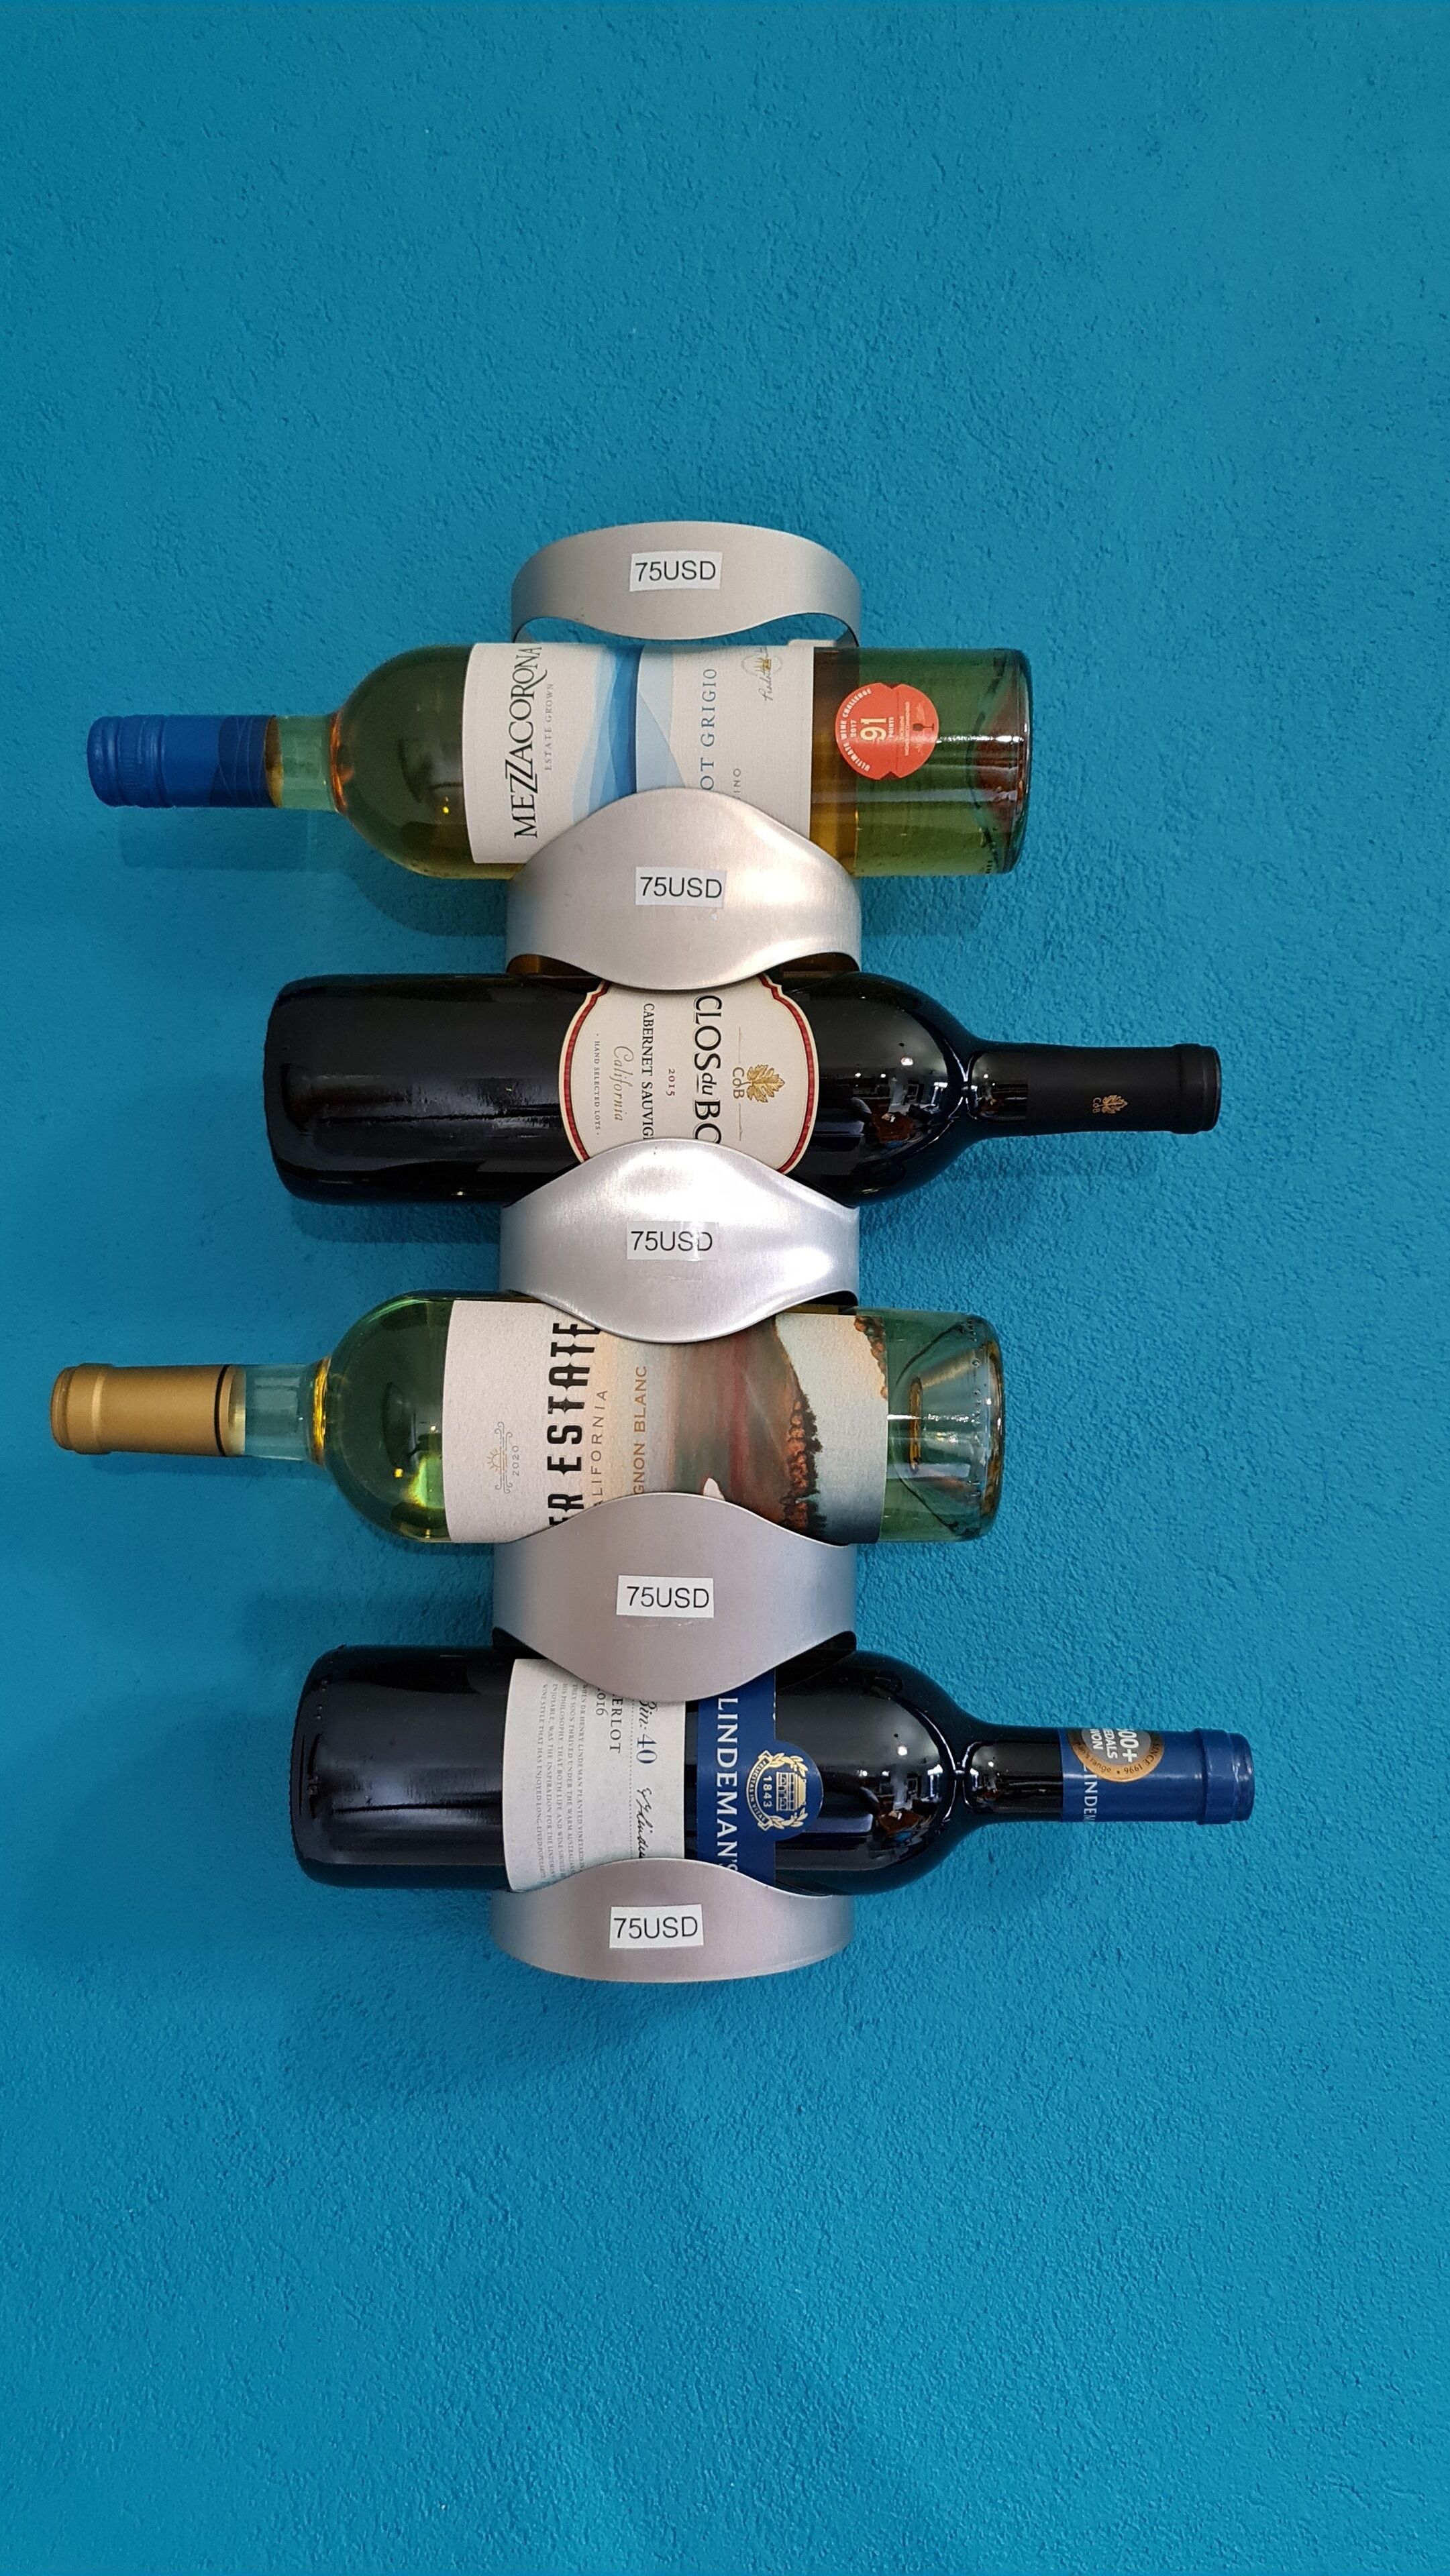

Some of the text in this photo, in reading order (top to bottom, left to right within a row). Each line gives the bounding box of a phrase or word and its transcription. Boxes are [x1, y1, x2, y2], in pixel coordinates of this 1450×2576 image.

[635, 559, 717, 582] 75USD
[701, 669, 717, 747] GRIGIO
[505, 646, 548, 839] MEZZACORONA
[544, 683, 554, 771] ESTATE GROWN
[839, 688, 872, 772] ULTIMATE WINE CHALLENGE
[860, 718, 887, 741] 91
[639, 876, 723, 898] 75USD
[641, 1003, 655, 1077] CABERNET
[694, 995, 723, 1071] CLOS
[609, 1046, 634, 1122] California
[666, 1068, 676, 1097] 2015
[701, 1072, 717, 1096] du
[631, 1230, 713, 1252] 75USD
[546, 1322, 602, 1476] ESTATE
[633, 1365, 648, 1433] BLANC
[512, 1445, 520, 1477] 2020
[626, 1586, 710, 1609] 75USD
[595, 1688, 609, 1716] 016
[609, 1694, 623, 1754] ERLOT
[635, 1733, 658, 1764] 40
[1102, 1729, 1119, 1759] EDALS
[1116, 1729, 1140, 1762] 00+
[1090, 1758, 1112, 1773] range
[1123, 1763, 1143, 1774] 1996
[763, 1775, 772, 1808] 1843
[1083, 1764, 1098, 1821] INDEM
[613, 1916, 698, 1939] 75USD
